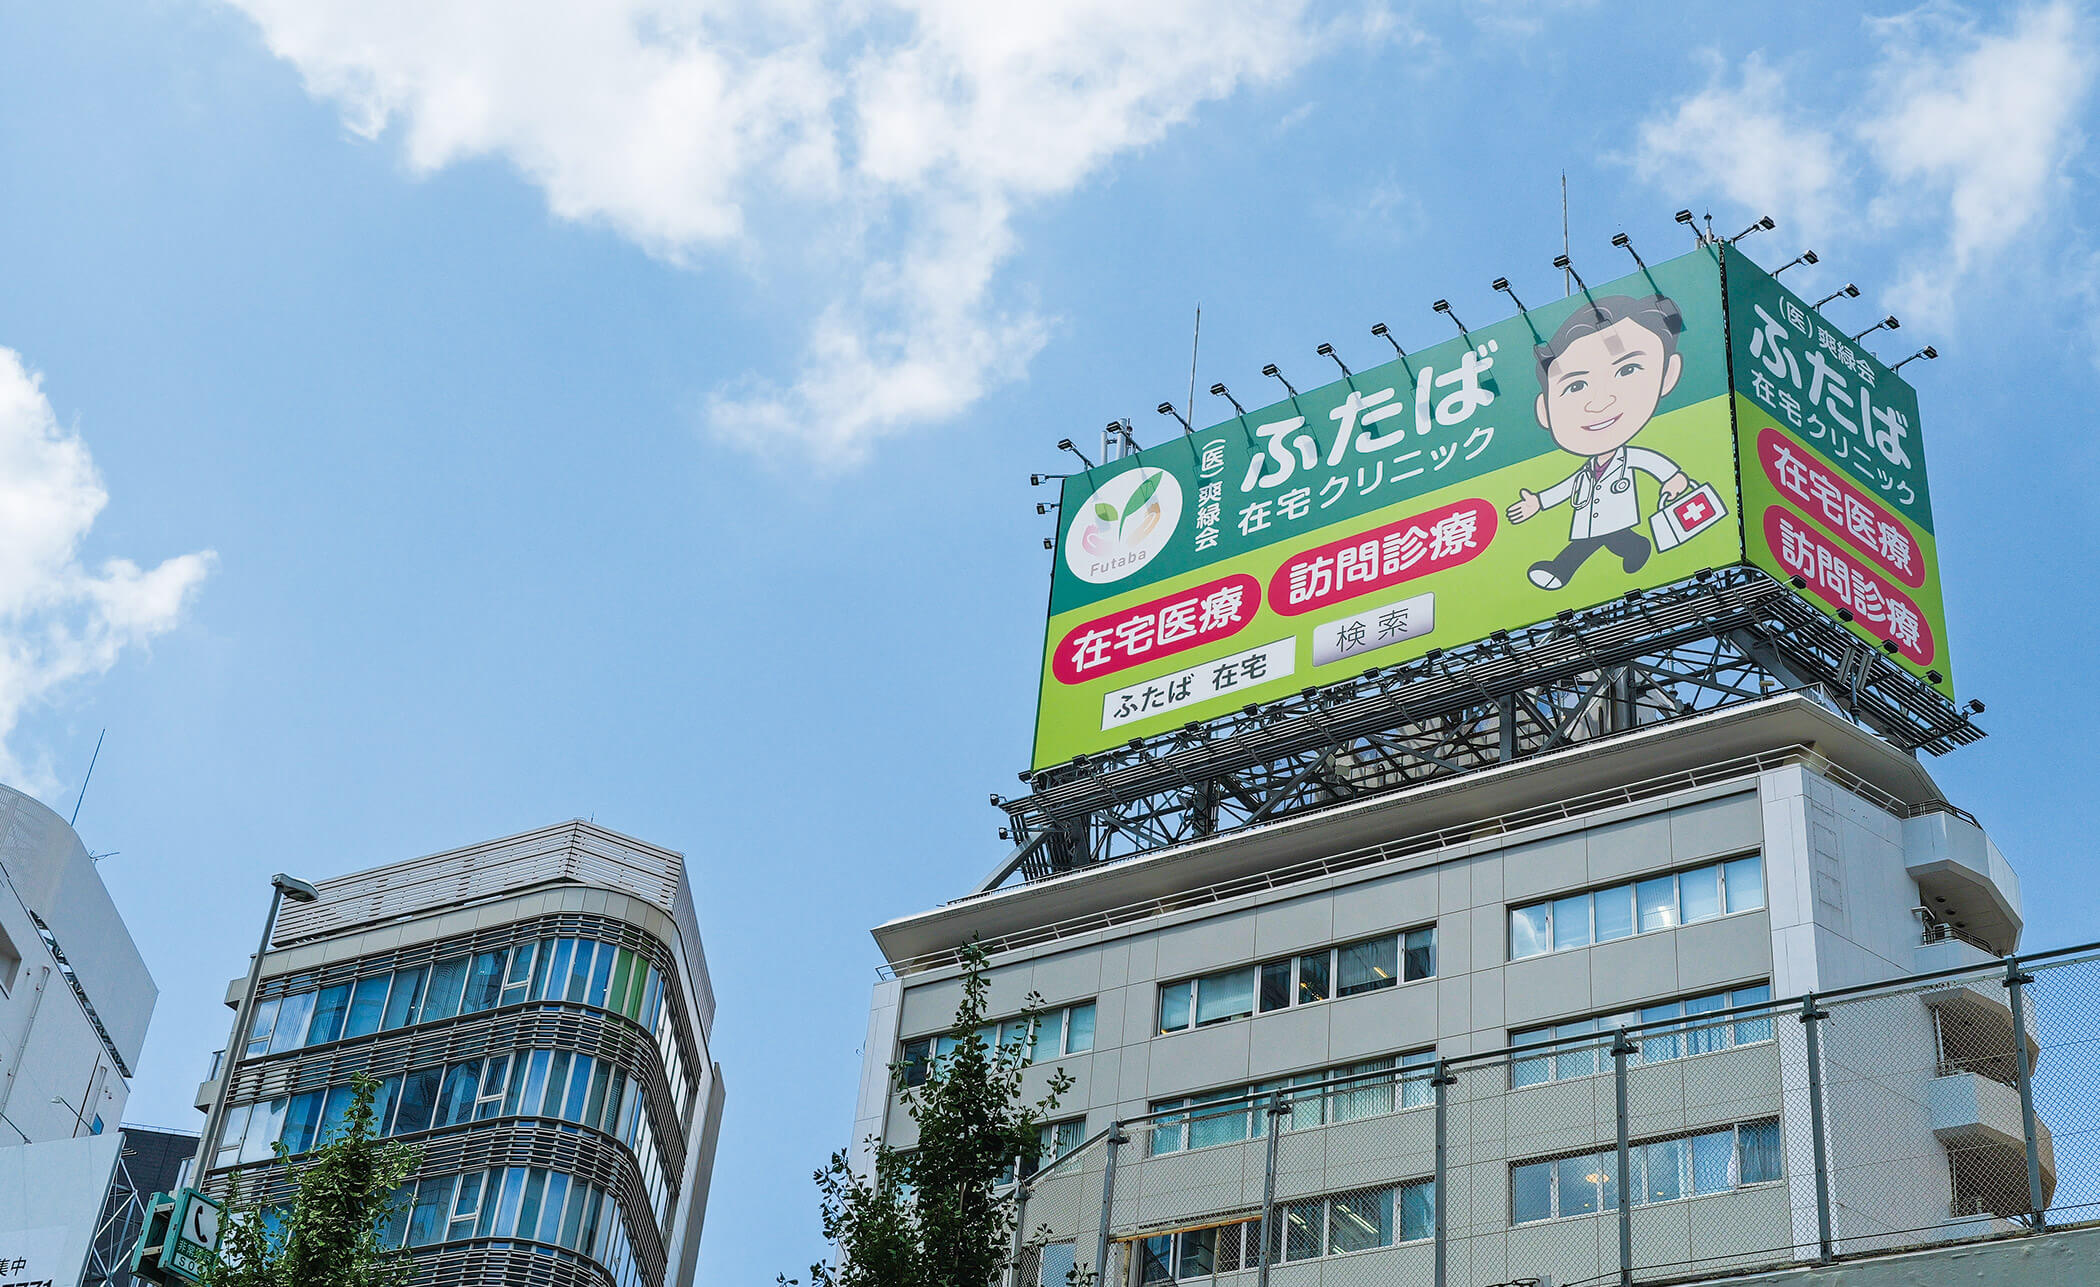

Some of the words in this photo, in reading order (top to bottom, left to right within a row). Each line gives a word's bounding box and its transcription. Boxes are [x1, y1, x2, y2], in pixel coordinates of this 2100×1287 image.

[1241, 339, 1499, 492] ふたば
[1750, 303, 1911, 470] ふたば
[1751, 369, 1915, 506] 在宅クリニック
[1238, 427, 1494, 536] 在宅クリニック
[1773, 443, 1913, 576] 在宅医療
[1090, 550, 1146, 576] Futaba
[1290, 509, 1477, 604] 訪問診療
[1779, 518, 1922, 654] 訪問診療
[1071, 584, 1244, 673] 在宅医療
[1336, 608, 1409, 652] 検索
[1114, 674, 1194, 719] ふたば
[1211, 653, 1267, 691] 在宅
